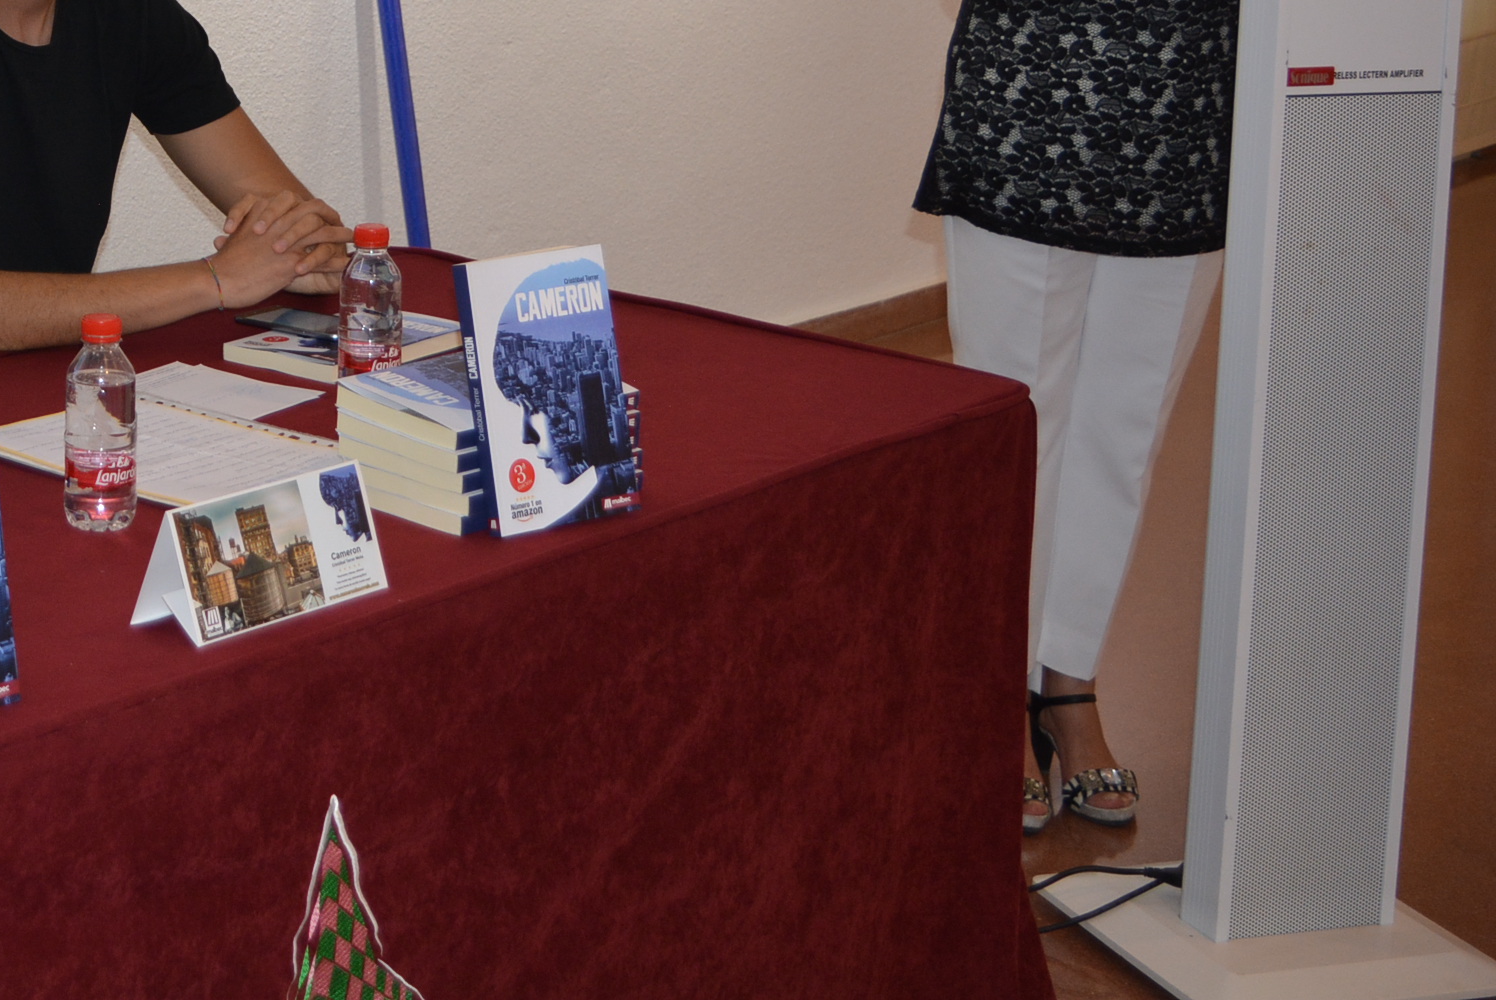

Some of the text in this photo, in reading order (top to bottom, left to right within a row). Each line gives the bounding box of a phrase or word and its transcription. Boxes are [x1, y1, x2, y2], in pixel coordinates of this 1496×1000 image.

[1359, 70, 1389, 79] LECTERN
[1390, 69, 1425, 78] AMPLIFIER
[515, 281, 604, 323] CAMERON
[464, 336, 479, 380] CAMERON
[369, 370, 460, 406] CAMERON
[472, 387, 481, 409] Terrer
[511, 506, 544, 520] amazon
[331, 546, 362, 561] Cameron
